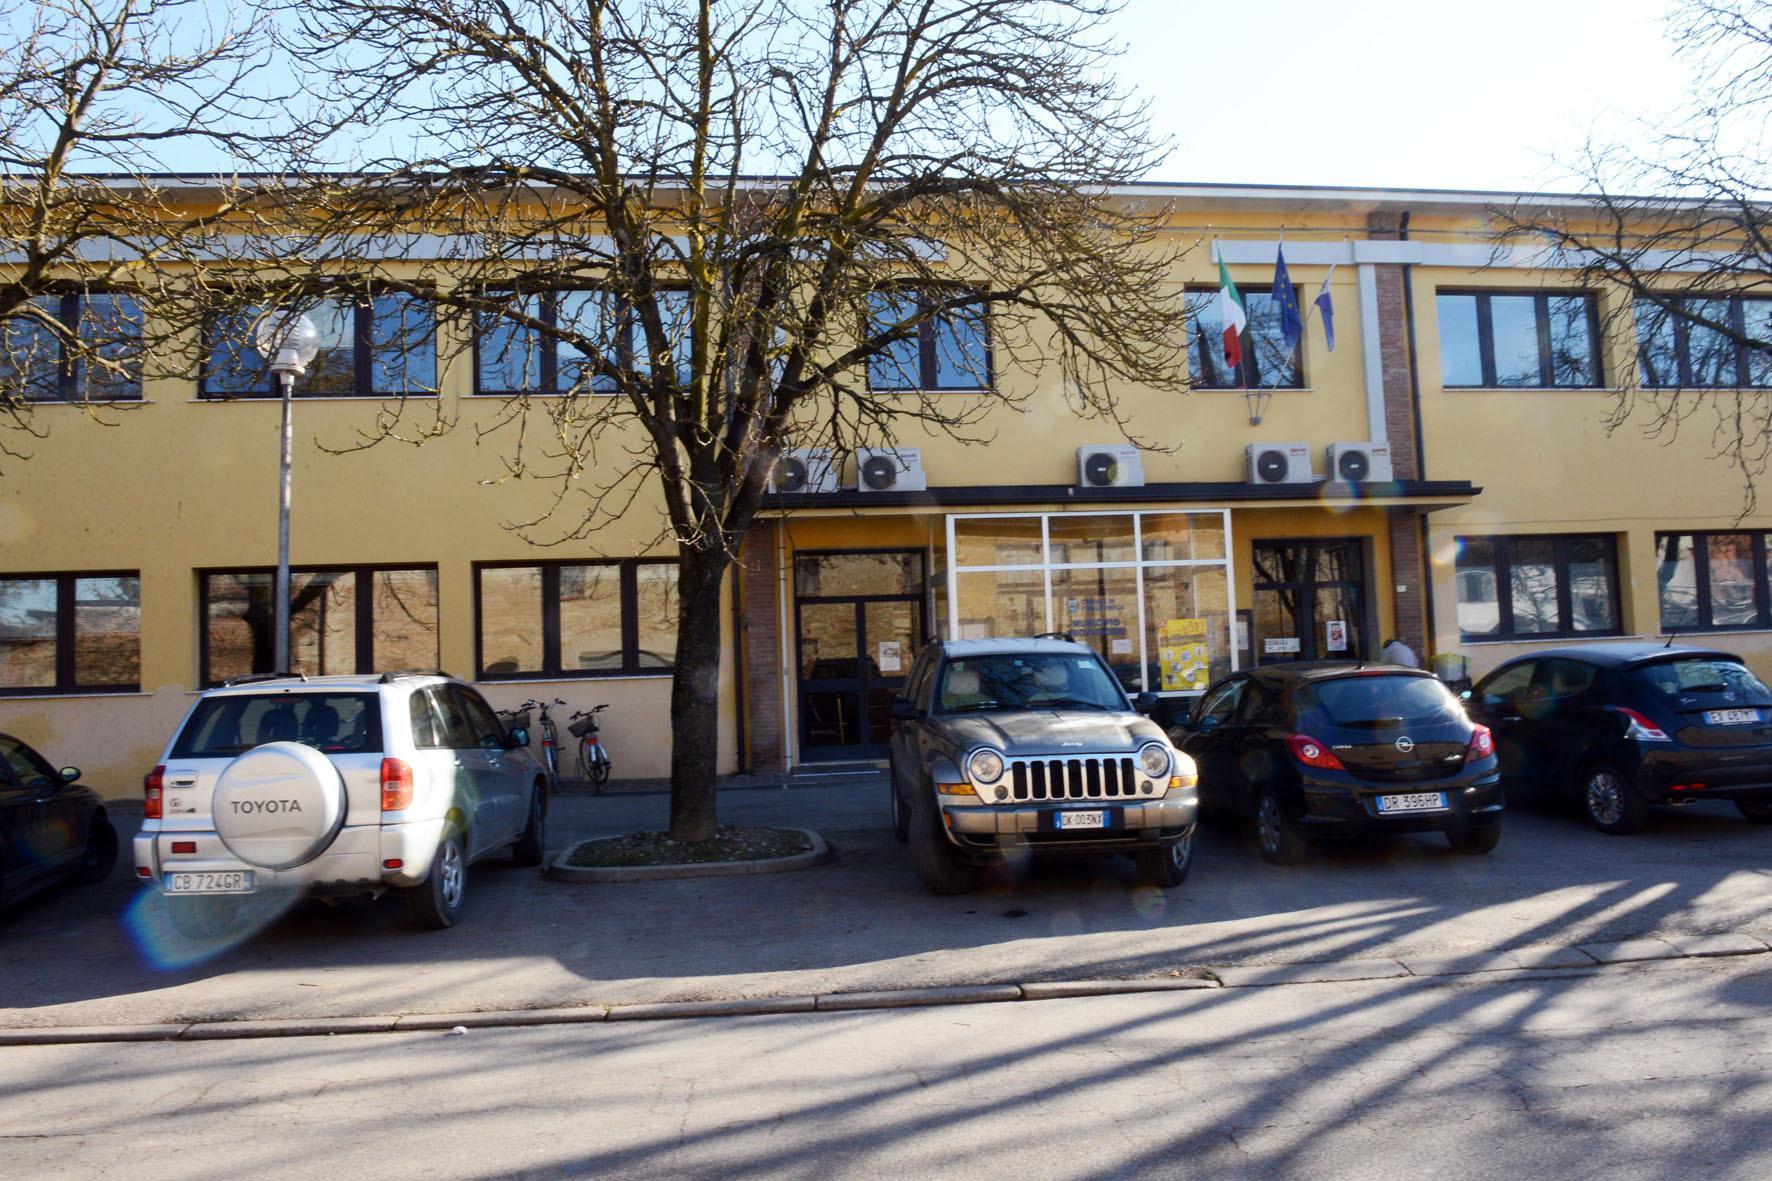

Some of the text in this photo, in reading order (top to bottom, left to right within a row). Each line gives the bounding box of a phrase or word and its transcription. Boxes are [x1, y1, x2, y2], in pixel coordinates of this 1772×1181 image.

[231, 799, 302, 814] TOYOTA
[1383, 793, 1439, 810] DR 396HP
[174, 873, 242, 890] CB 724GR
